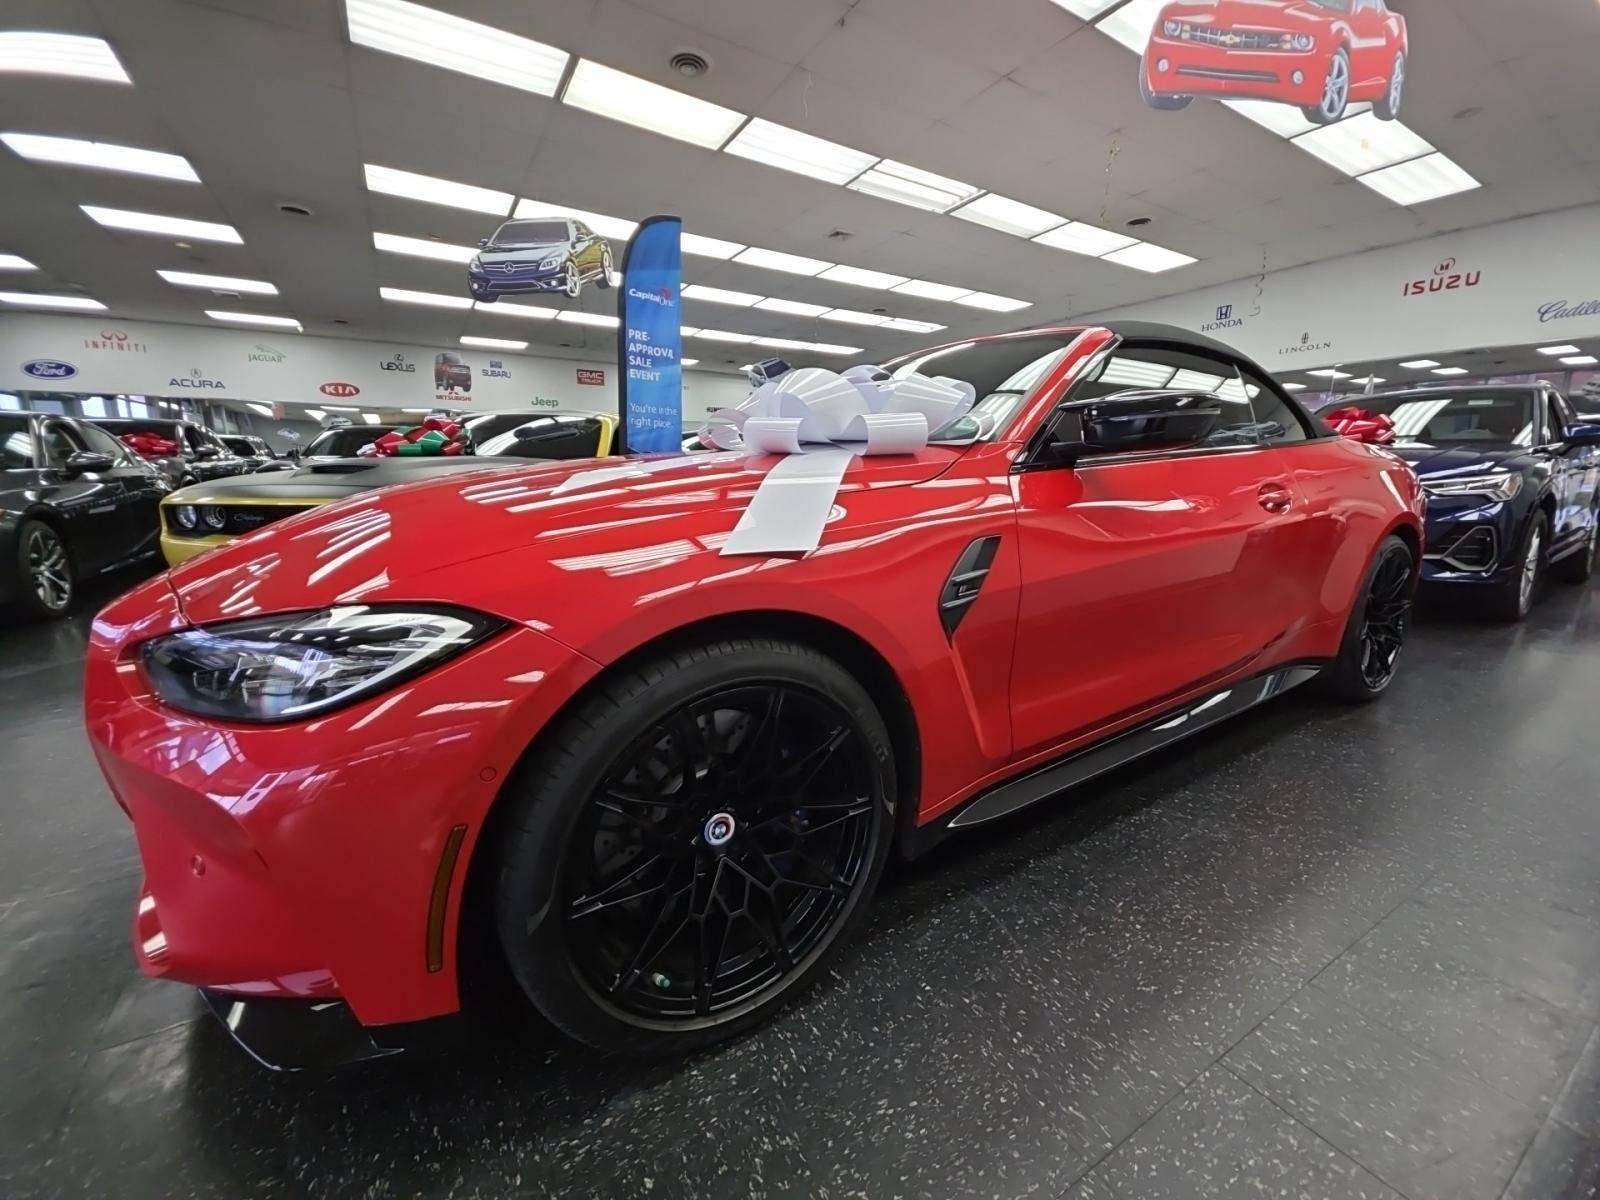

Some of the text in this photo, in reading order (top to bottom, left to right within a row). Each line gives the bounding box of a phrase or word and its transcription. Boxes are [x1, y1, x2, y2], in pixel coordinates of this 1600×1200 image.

[1403, 271, 1481, 296] ISUZU
[1201, 318, 1243, 332] HONDA
[84, 340, 147, 353] INFINITI
[1279, 341, 1331, 355] LINCOLN
[248, 353, 282, 362] JAGUAR
[629, 355, 652, 367] SALE
[32, 363, 66, 376] Ford
[380, 361, 416, 372] LEXUS
[481, 369, 512, 379] SUBARU
[578, 371, 604, 380] GMC
[629, 368, 661, 381] EVENT
[169, 378, 226, 390] ACURA
[325, 385, 356, 394] KIA
[531, 396, 559, 408] Jeep
[630, 402, 657, 414] You're
